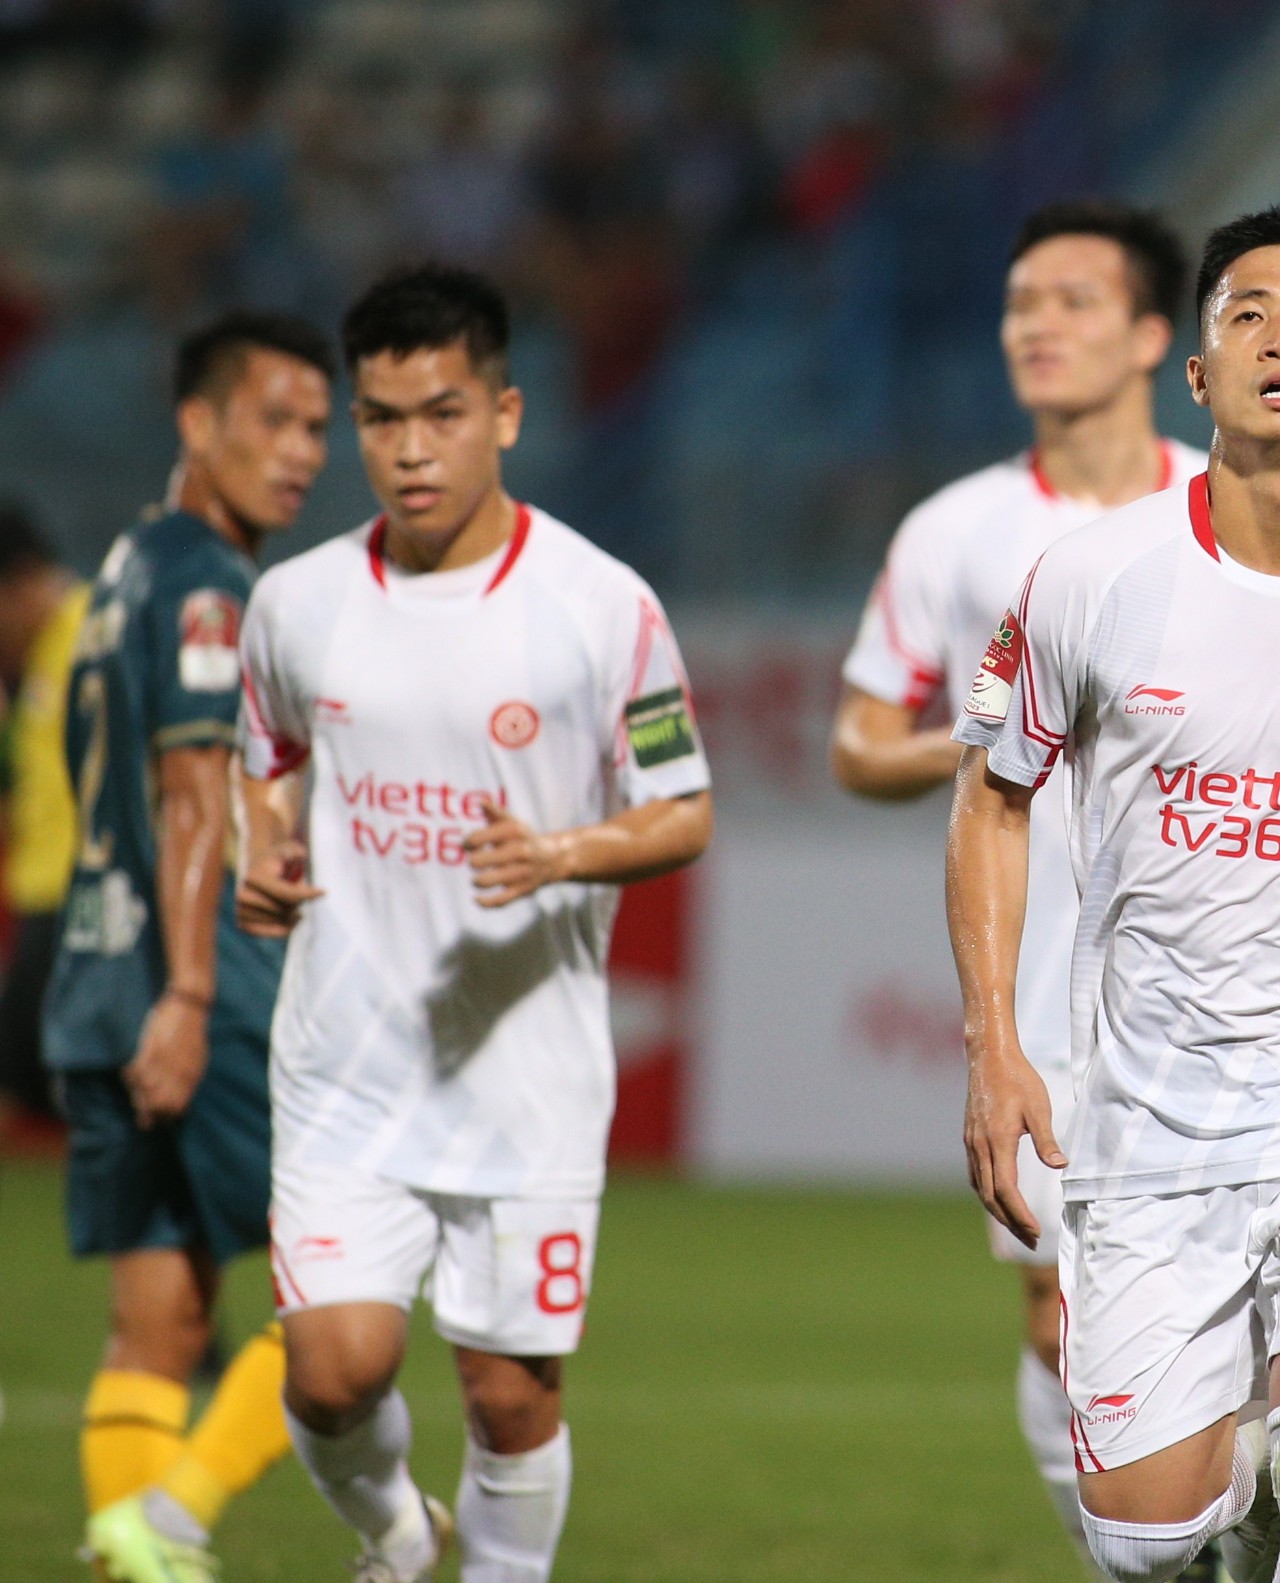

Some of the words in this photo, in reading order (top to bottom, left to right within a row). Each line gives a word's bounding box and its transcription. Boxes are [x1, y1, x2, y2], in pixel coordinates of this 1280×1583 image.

[1125, 704, 1186, 716] LI-NING
[350, 818, 466, 867] tv36
[535, 1231, 584, 1315] 8
[1087, 1407, 1137, 1425] LI-NING
